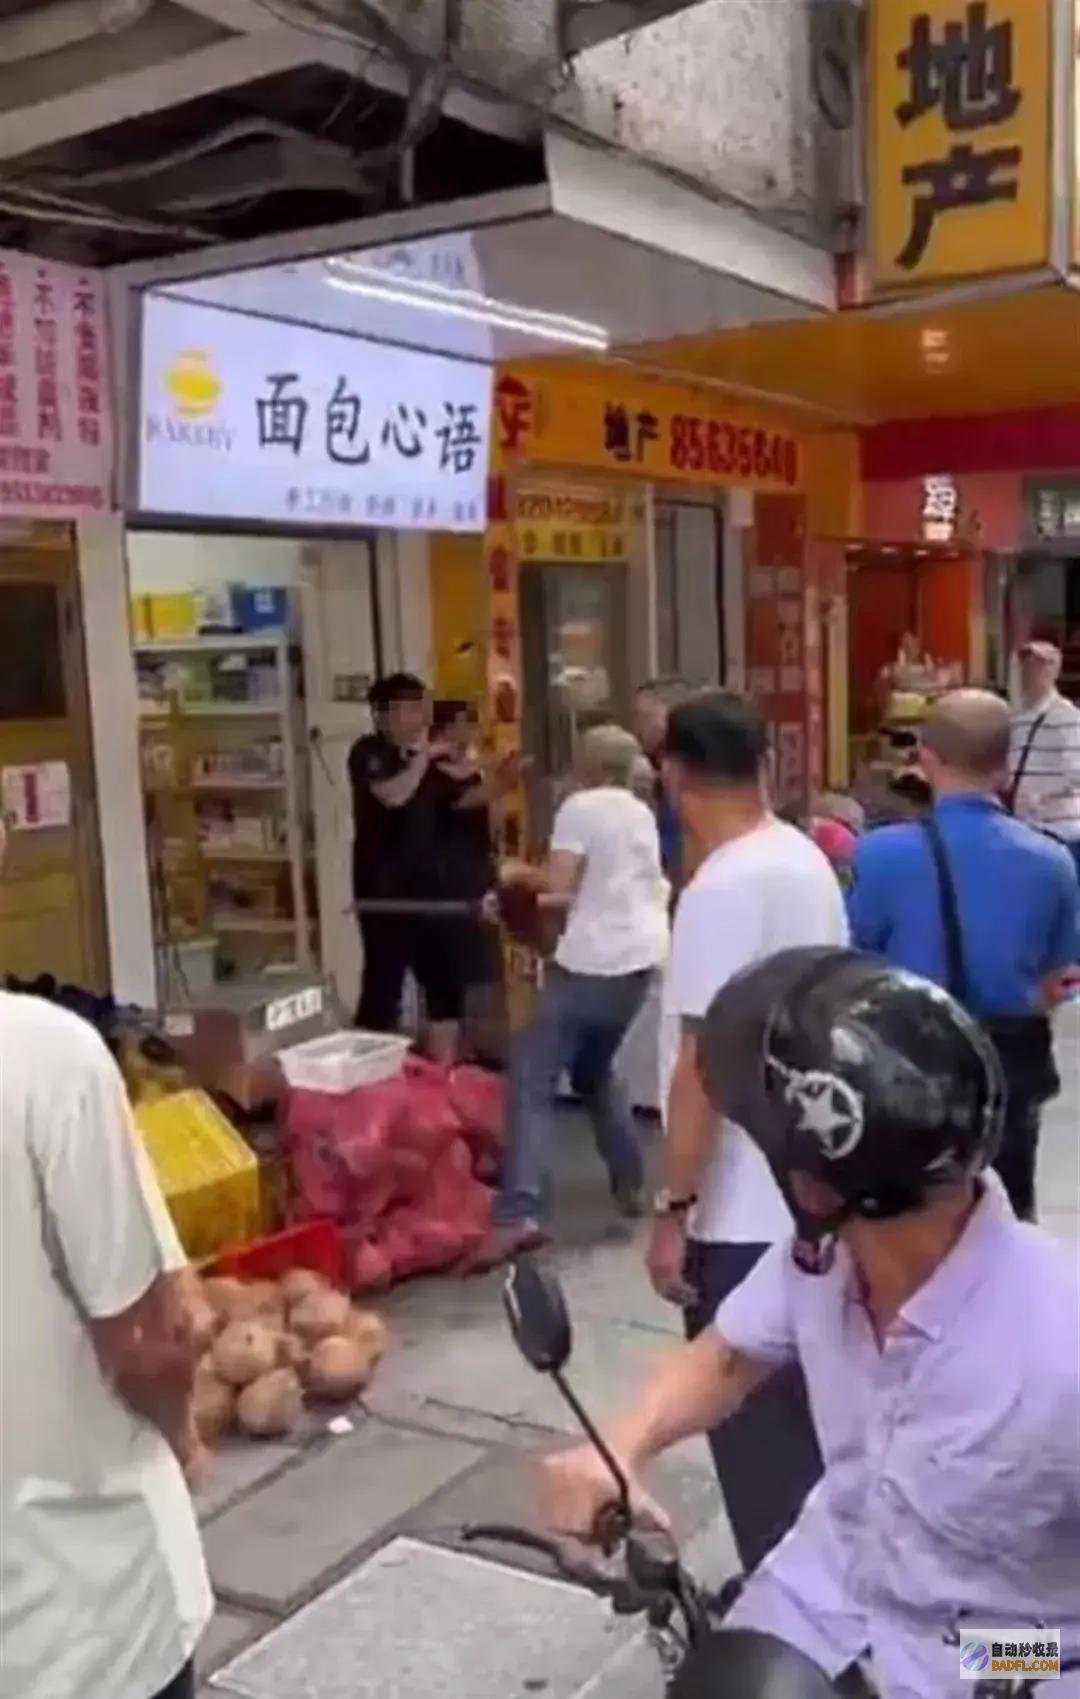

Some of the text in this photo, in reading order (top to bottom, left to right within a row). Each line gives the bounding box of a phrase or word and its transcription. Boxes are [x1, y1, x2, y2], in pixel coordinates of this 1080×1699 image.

[895, 2, 1021, 269] 地产
[256, 373, 481, 474] 面包心语
[604, 401, 659, 462] 地产
